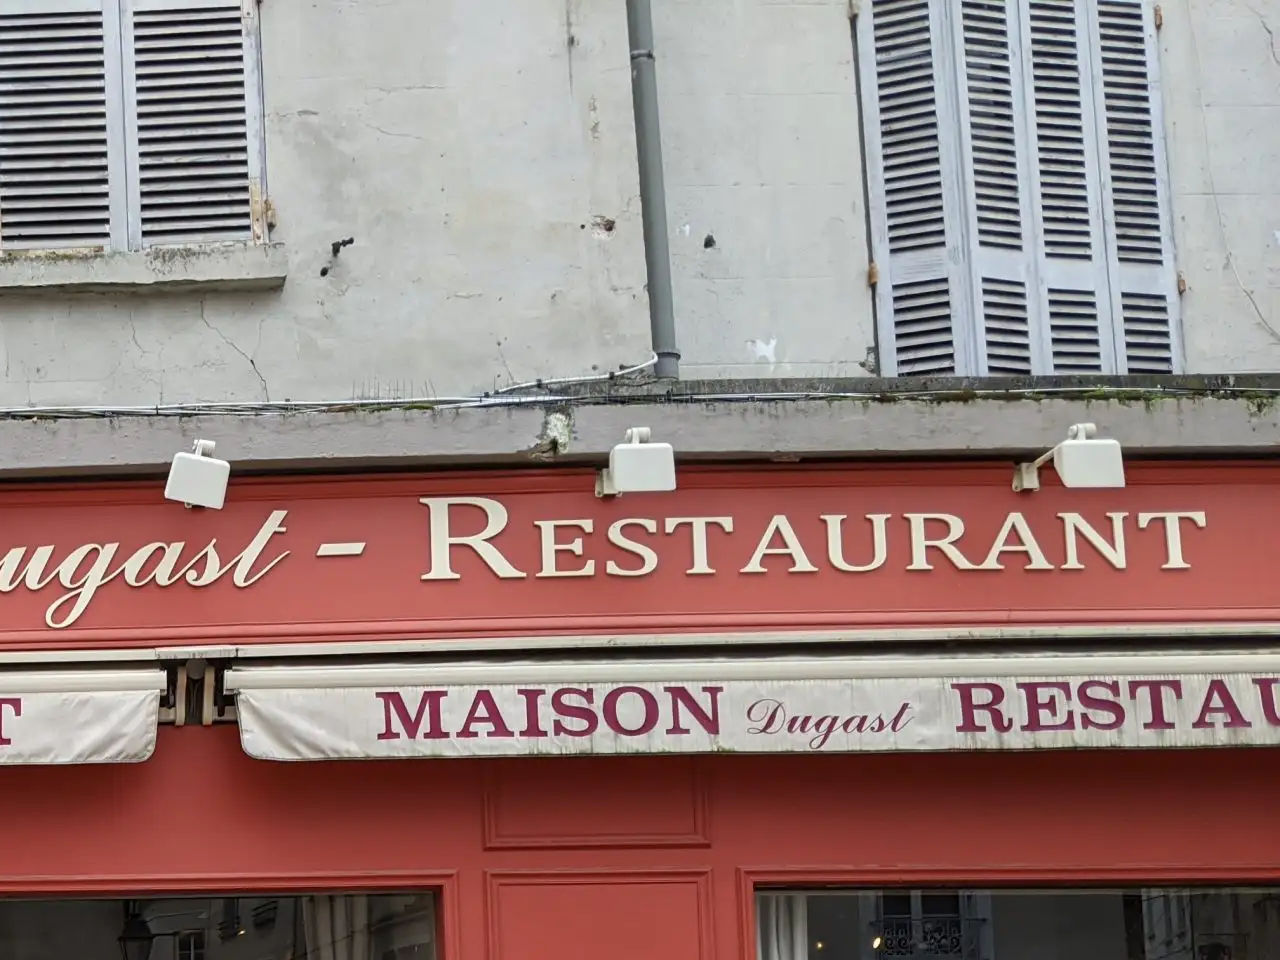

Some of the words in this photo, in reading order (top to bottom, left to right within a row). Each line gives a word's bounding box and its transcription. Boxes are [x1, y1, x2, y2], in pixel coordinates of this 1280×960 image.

[419, 496, 1206, 581] RESTAURANT
[375, 686, 724, 740] MAISON
[746, 698, 915, 749] Dugast
